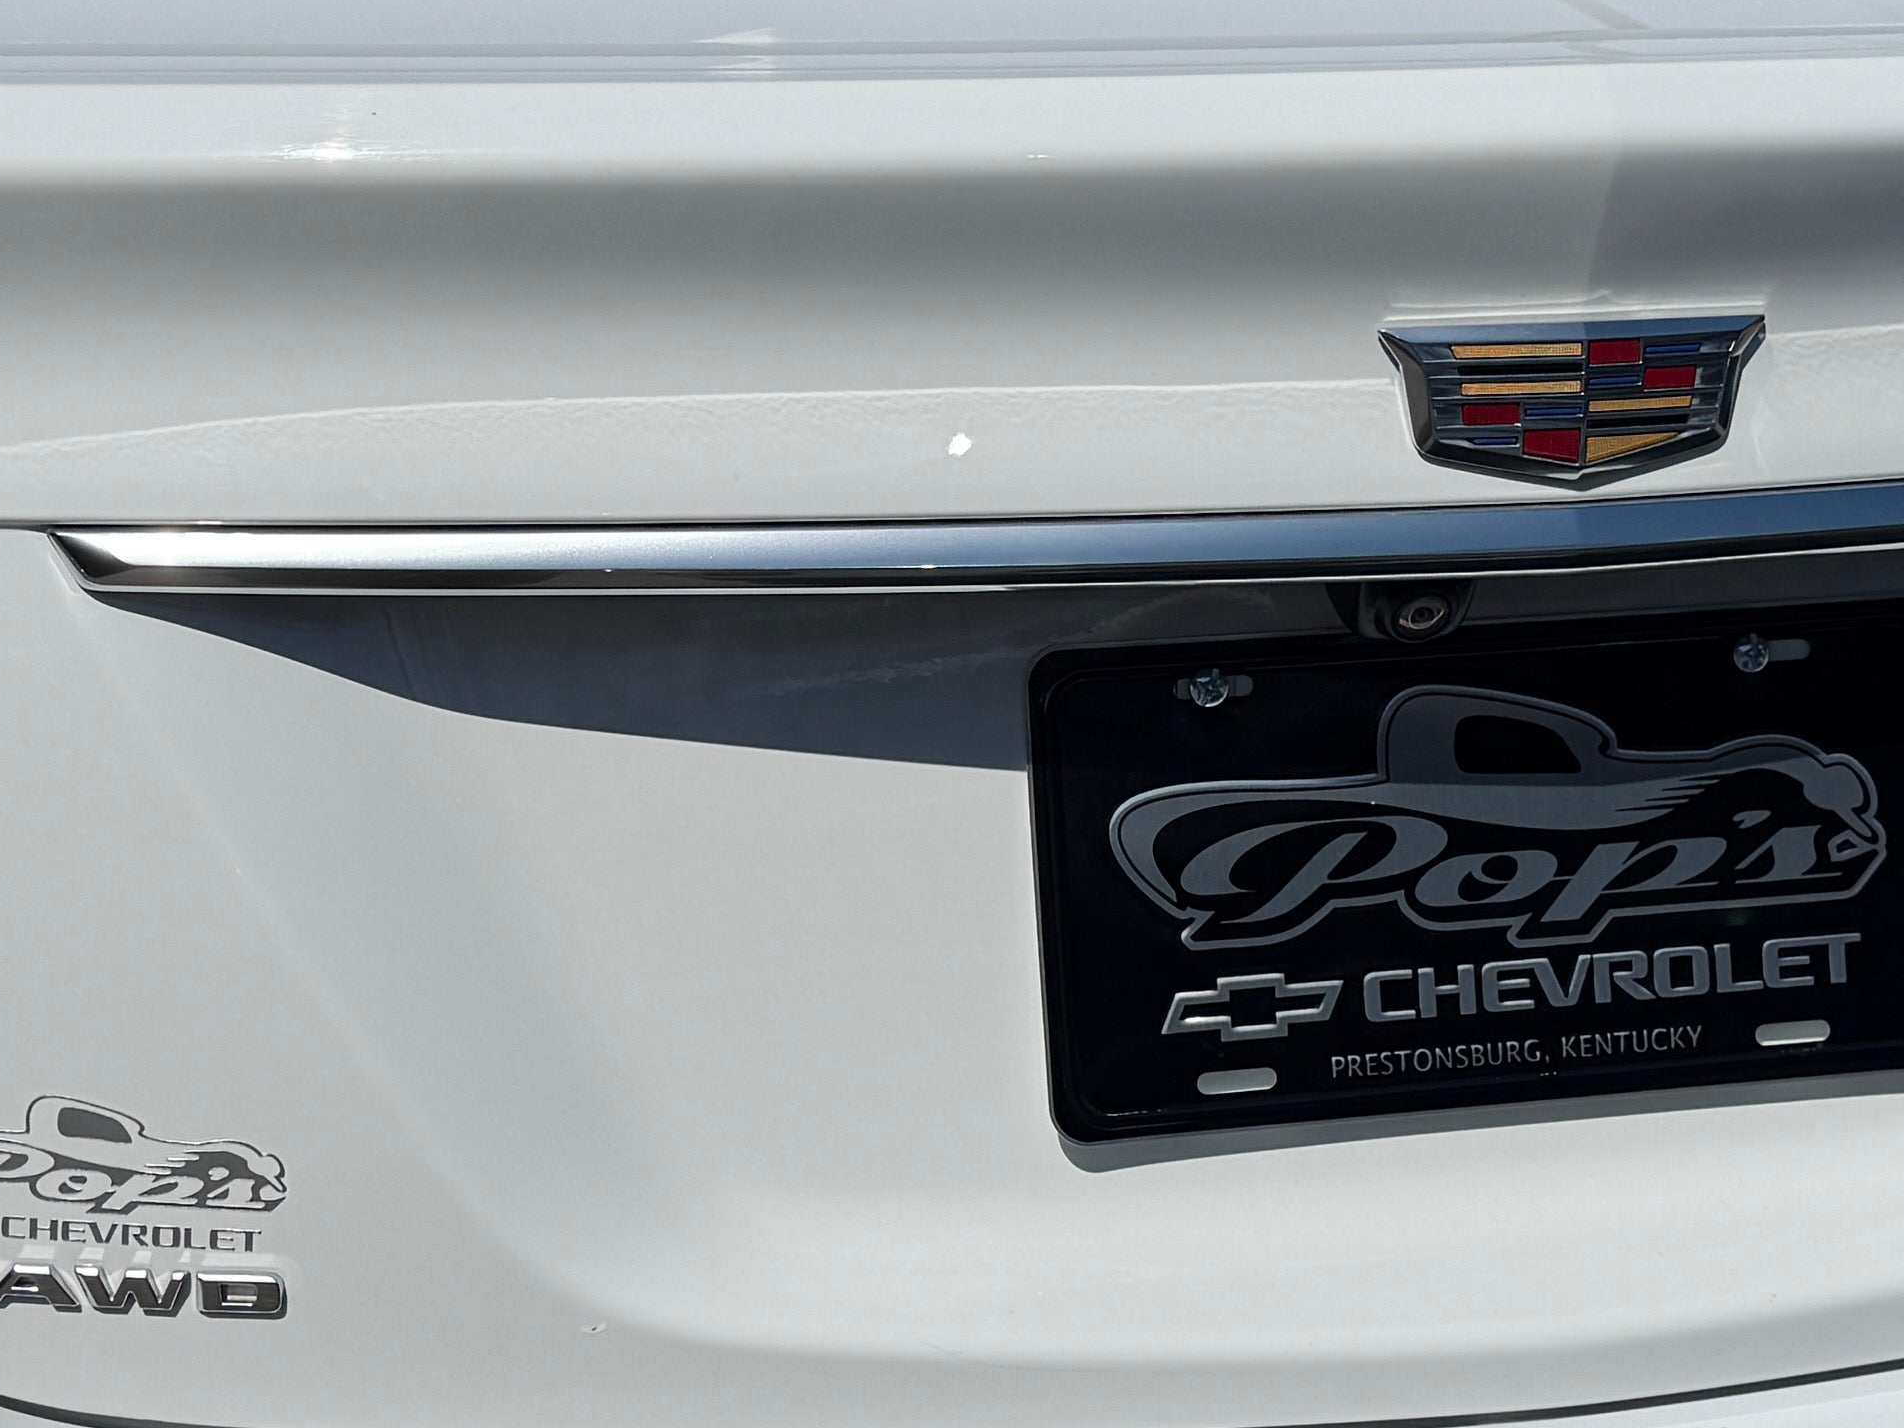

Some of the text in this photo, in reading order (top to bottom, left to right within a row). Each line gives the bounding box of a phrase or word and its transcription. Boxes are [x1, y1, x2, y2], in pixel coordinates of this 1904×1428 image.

[1180, 808, 1846, 925] Pop's
[1361, 931, 1863, 1025] CHEVROLET
[1329, 1024, 1704, 1080] PRESTONSBURG, KENTUCKY
[0, 1215, 262, 1253] CHEVROLET
